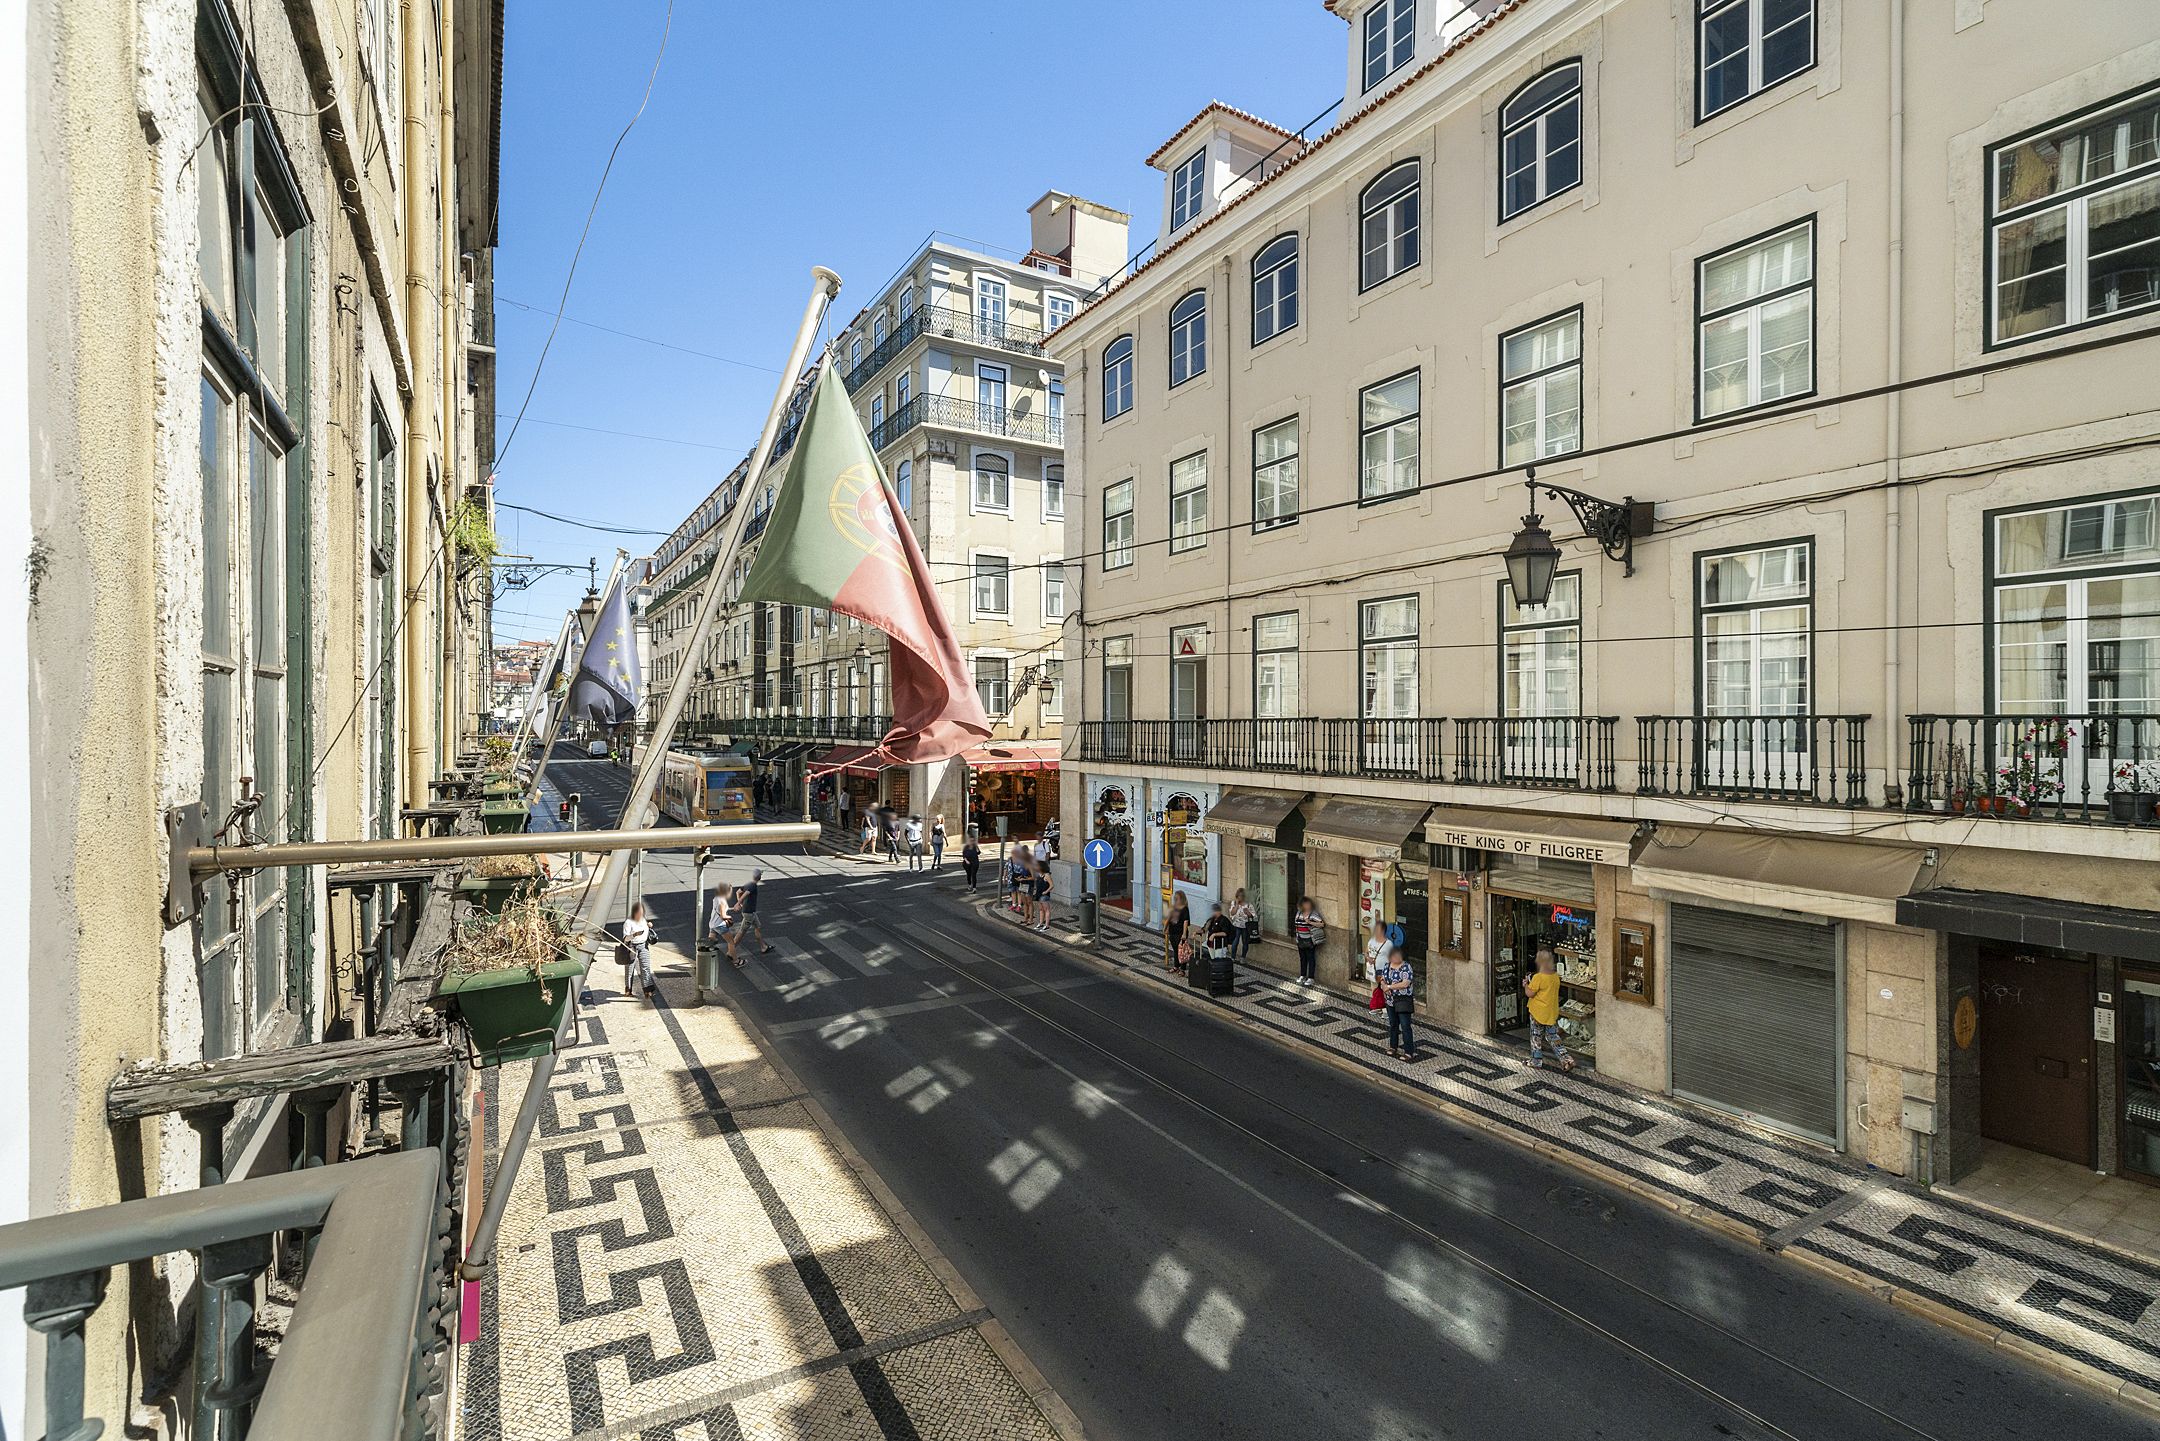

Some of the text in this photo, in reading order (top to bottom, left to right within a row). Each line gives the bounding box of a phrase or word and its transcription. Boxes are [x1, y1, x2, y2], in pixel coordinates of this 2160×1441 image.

[1306, 838, 1329, 848] PRATA
[1445, 832, 1604, 861] THE KING OF FILIGREE
